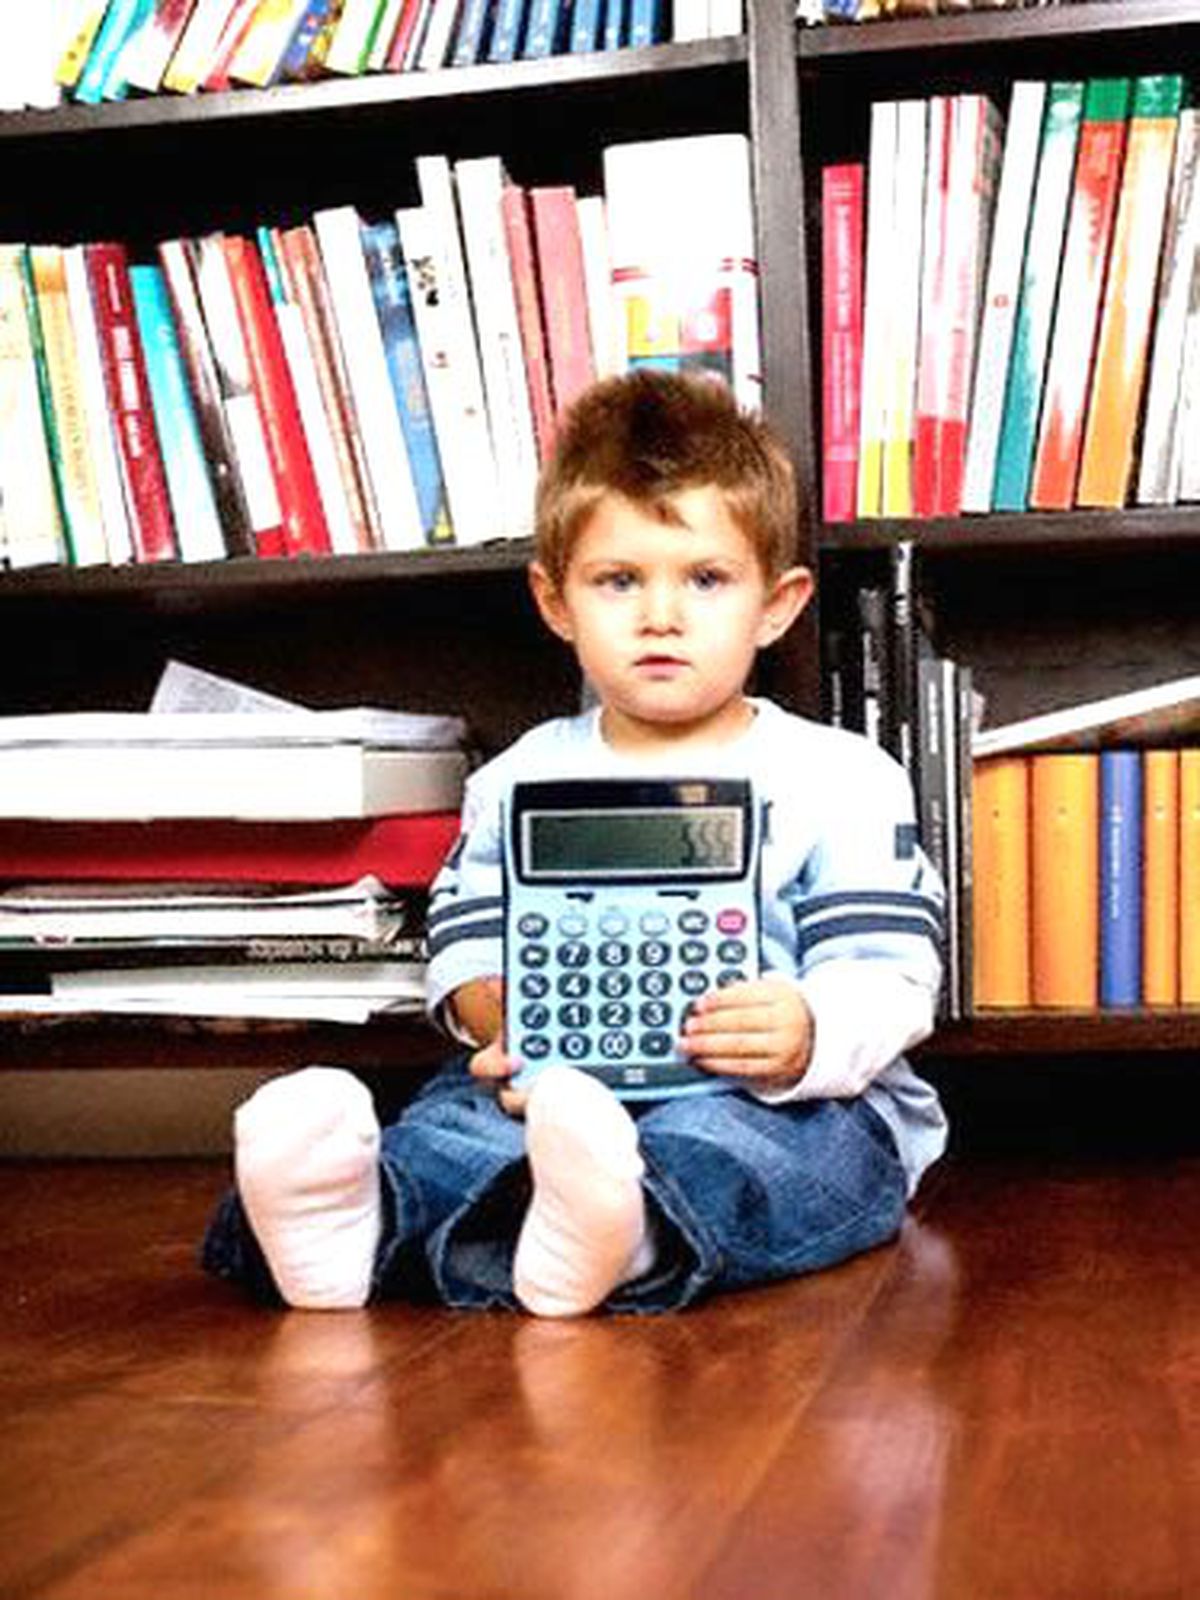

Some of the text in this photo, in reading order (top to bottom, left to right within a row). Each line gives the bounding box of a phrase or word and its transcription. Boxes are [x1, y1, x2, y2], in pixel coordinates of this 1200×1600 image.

[566, 942, 663, 964] 7 8 9
[565, 975, 581, 995] 4
[607, 974, 623, 995] 5
[646, 973, 663, 995] 6
[568, 1003, 664, 1025] 1 2 3
[565, 1034, 584, 1056] 0
